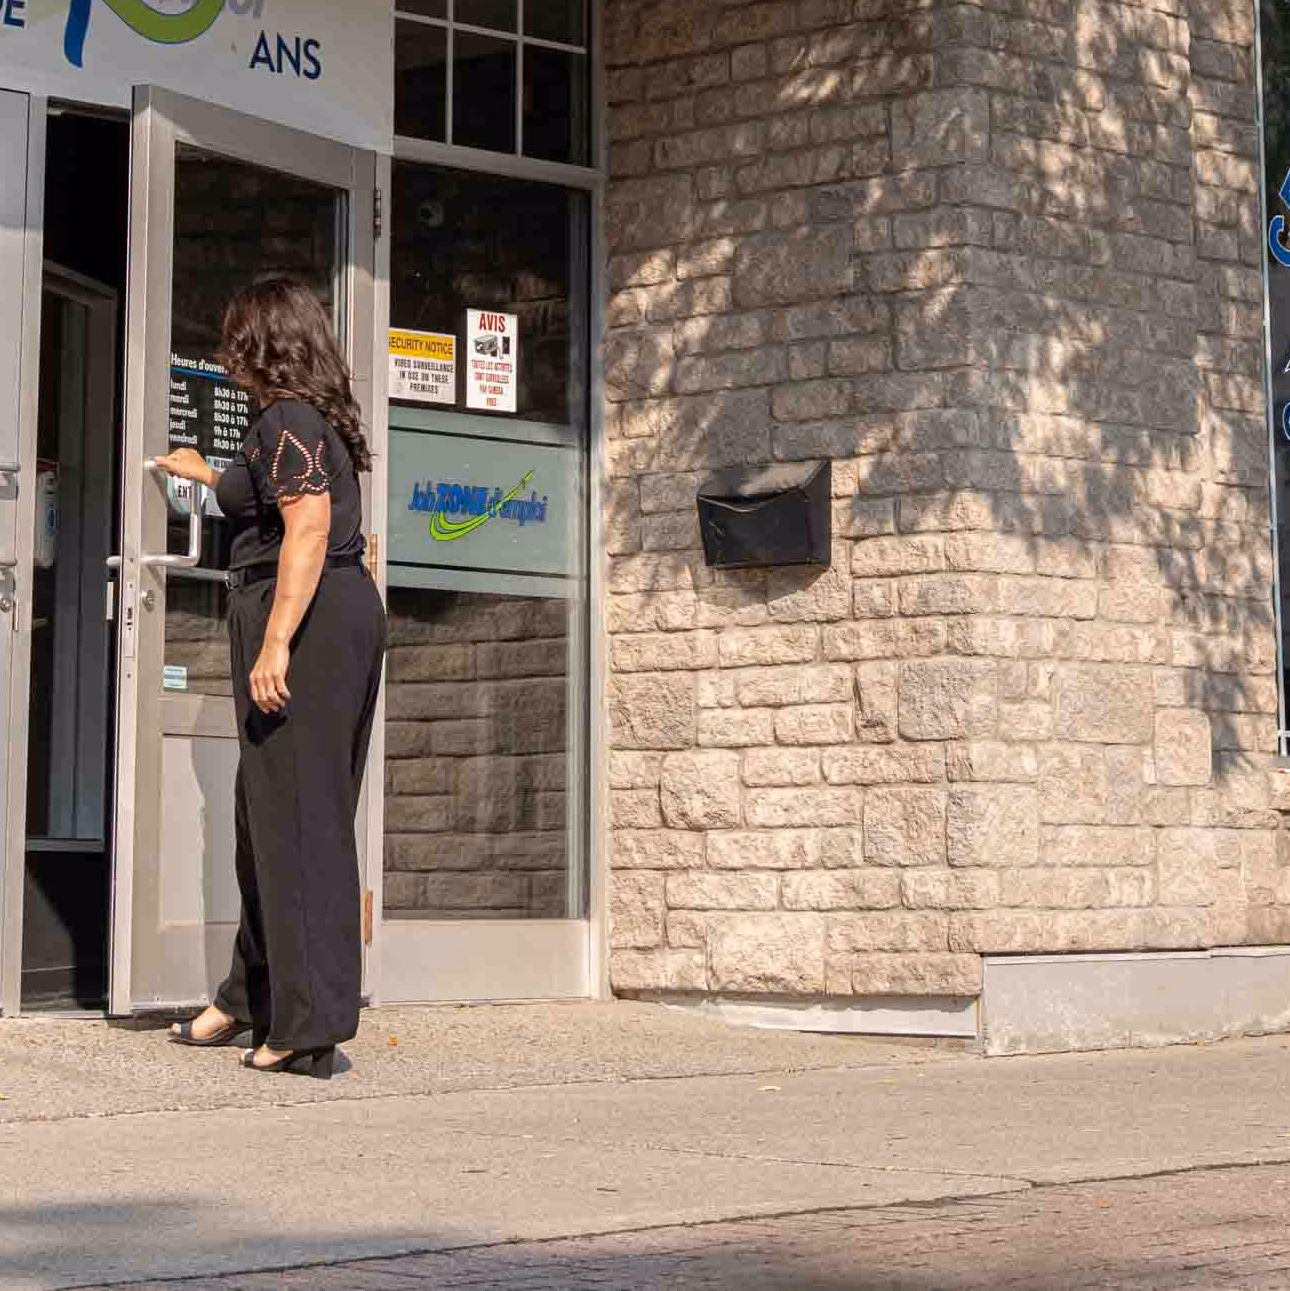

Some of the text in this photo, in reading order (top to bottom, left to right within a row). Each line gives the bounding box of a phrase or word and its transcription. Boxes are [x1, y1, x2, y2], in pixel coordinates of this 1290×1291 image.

[249, 30, 323, 81] ANS
[479, 313, 506, 333] AVIS
[425, 340, 453, 355] NOTICE
[171, 352, 198, 370] Heures
